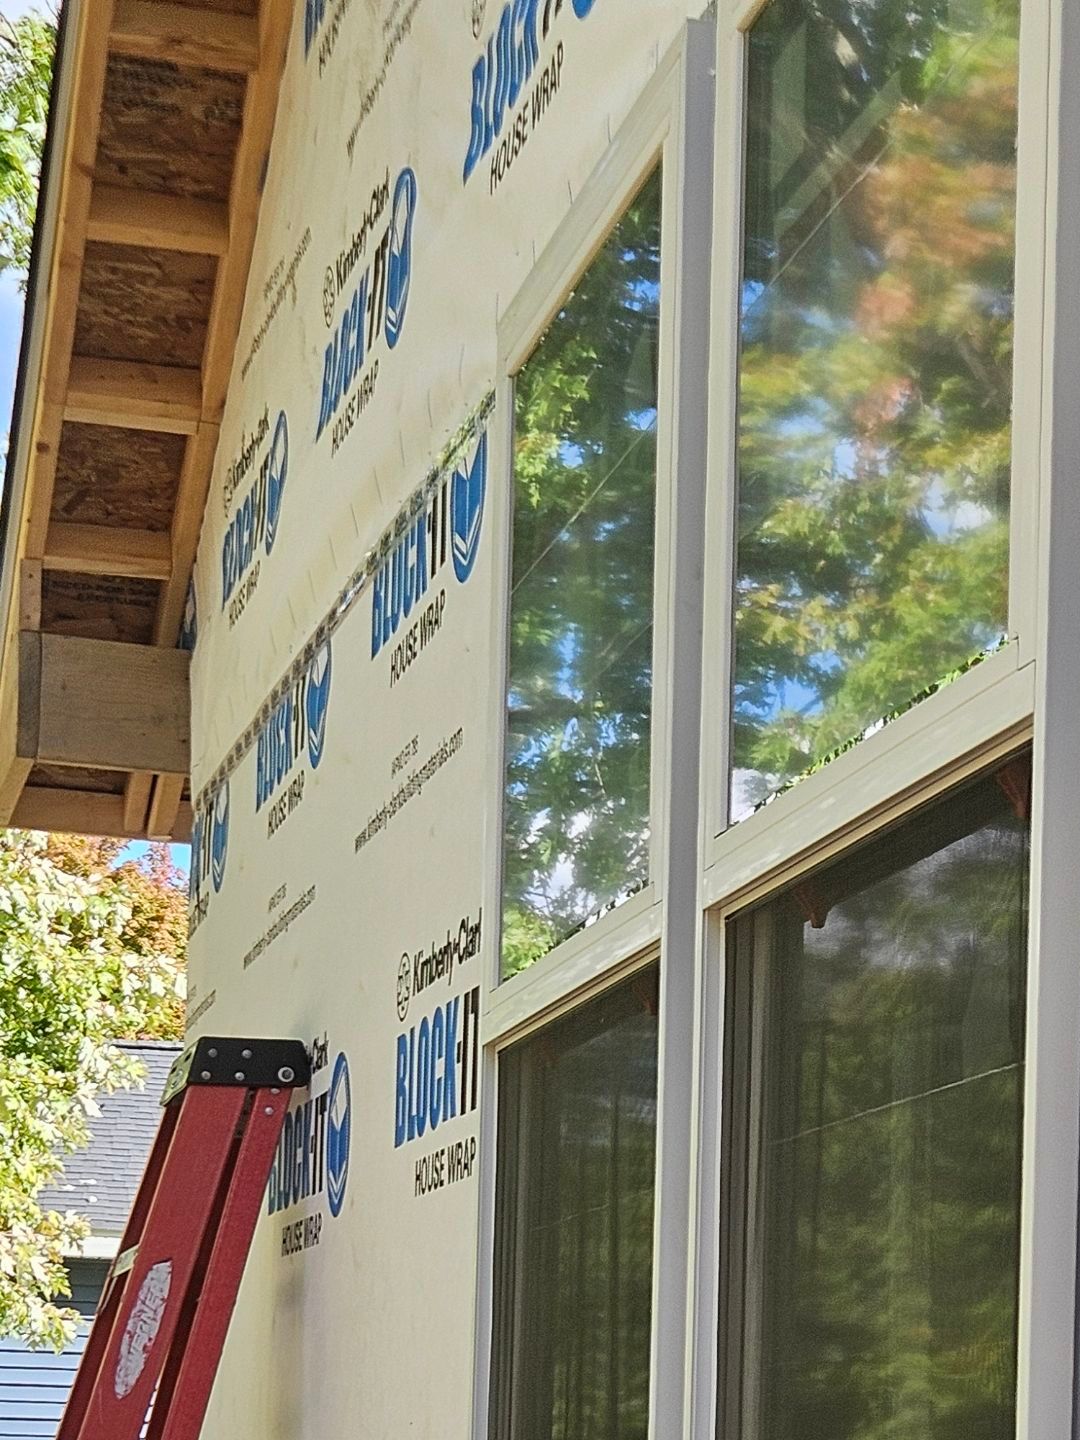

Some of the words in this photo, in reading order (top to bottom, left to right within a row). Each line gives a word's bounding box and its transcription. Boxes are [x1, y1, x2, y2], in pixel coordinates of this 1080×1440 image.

[490, 100, 529, 196] HOUSE
[531, 40, 564, 131] WRAP
[390, 620, 418, 689] HOUSE
[420, 588, 446, 653] WRAP
[394, 985, 481, 1149] BLOCK-IT
[414, 1147, 446, 1198] HOUSE
[447, 1136, 477, 1186] WRAP
